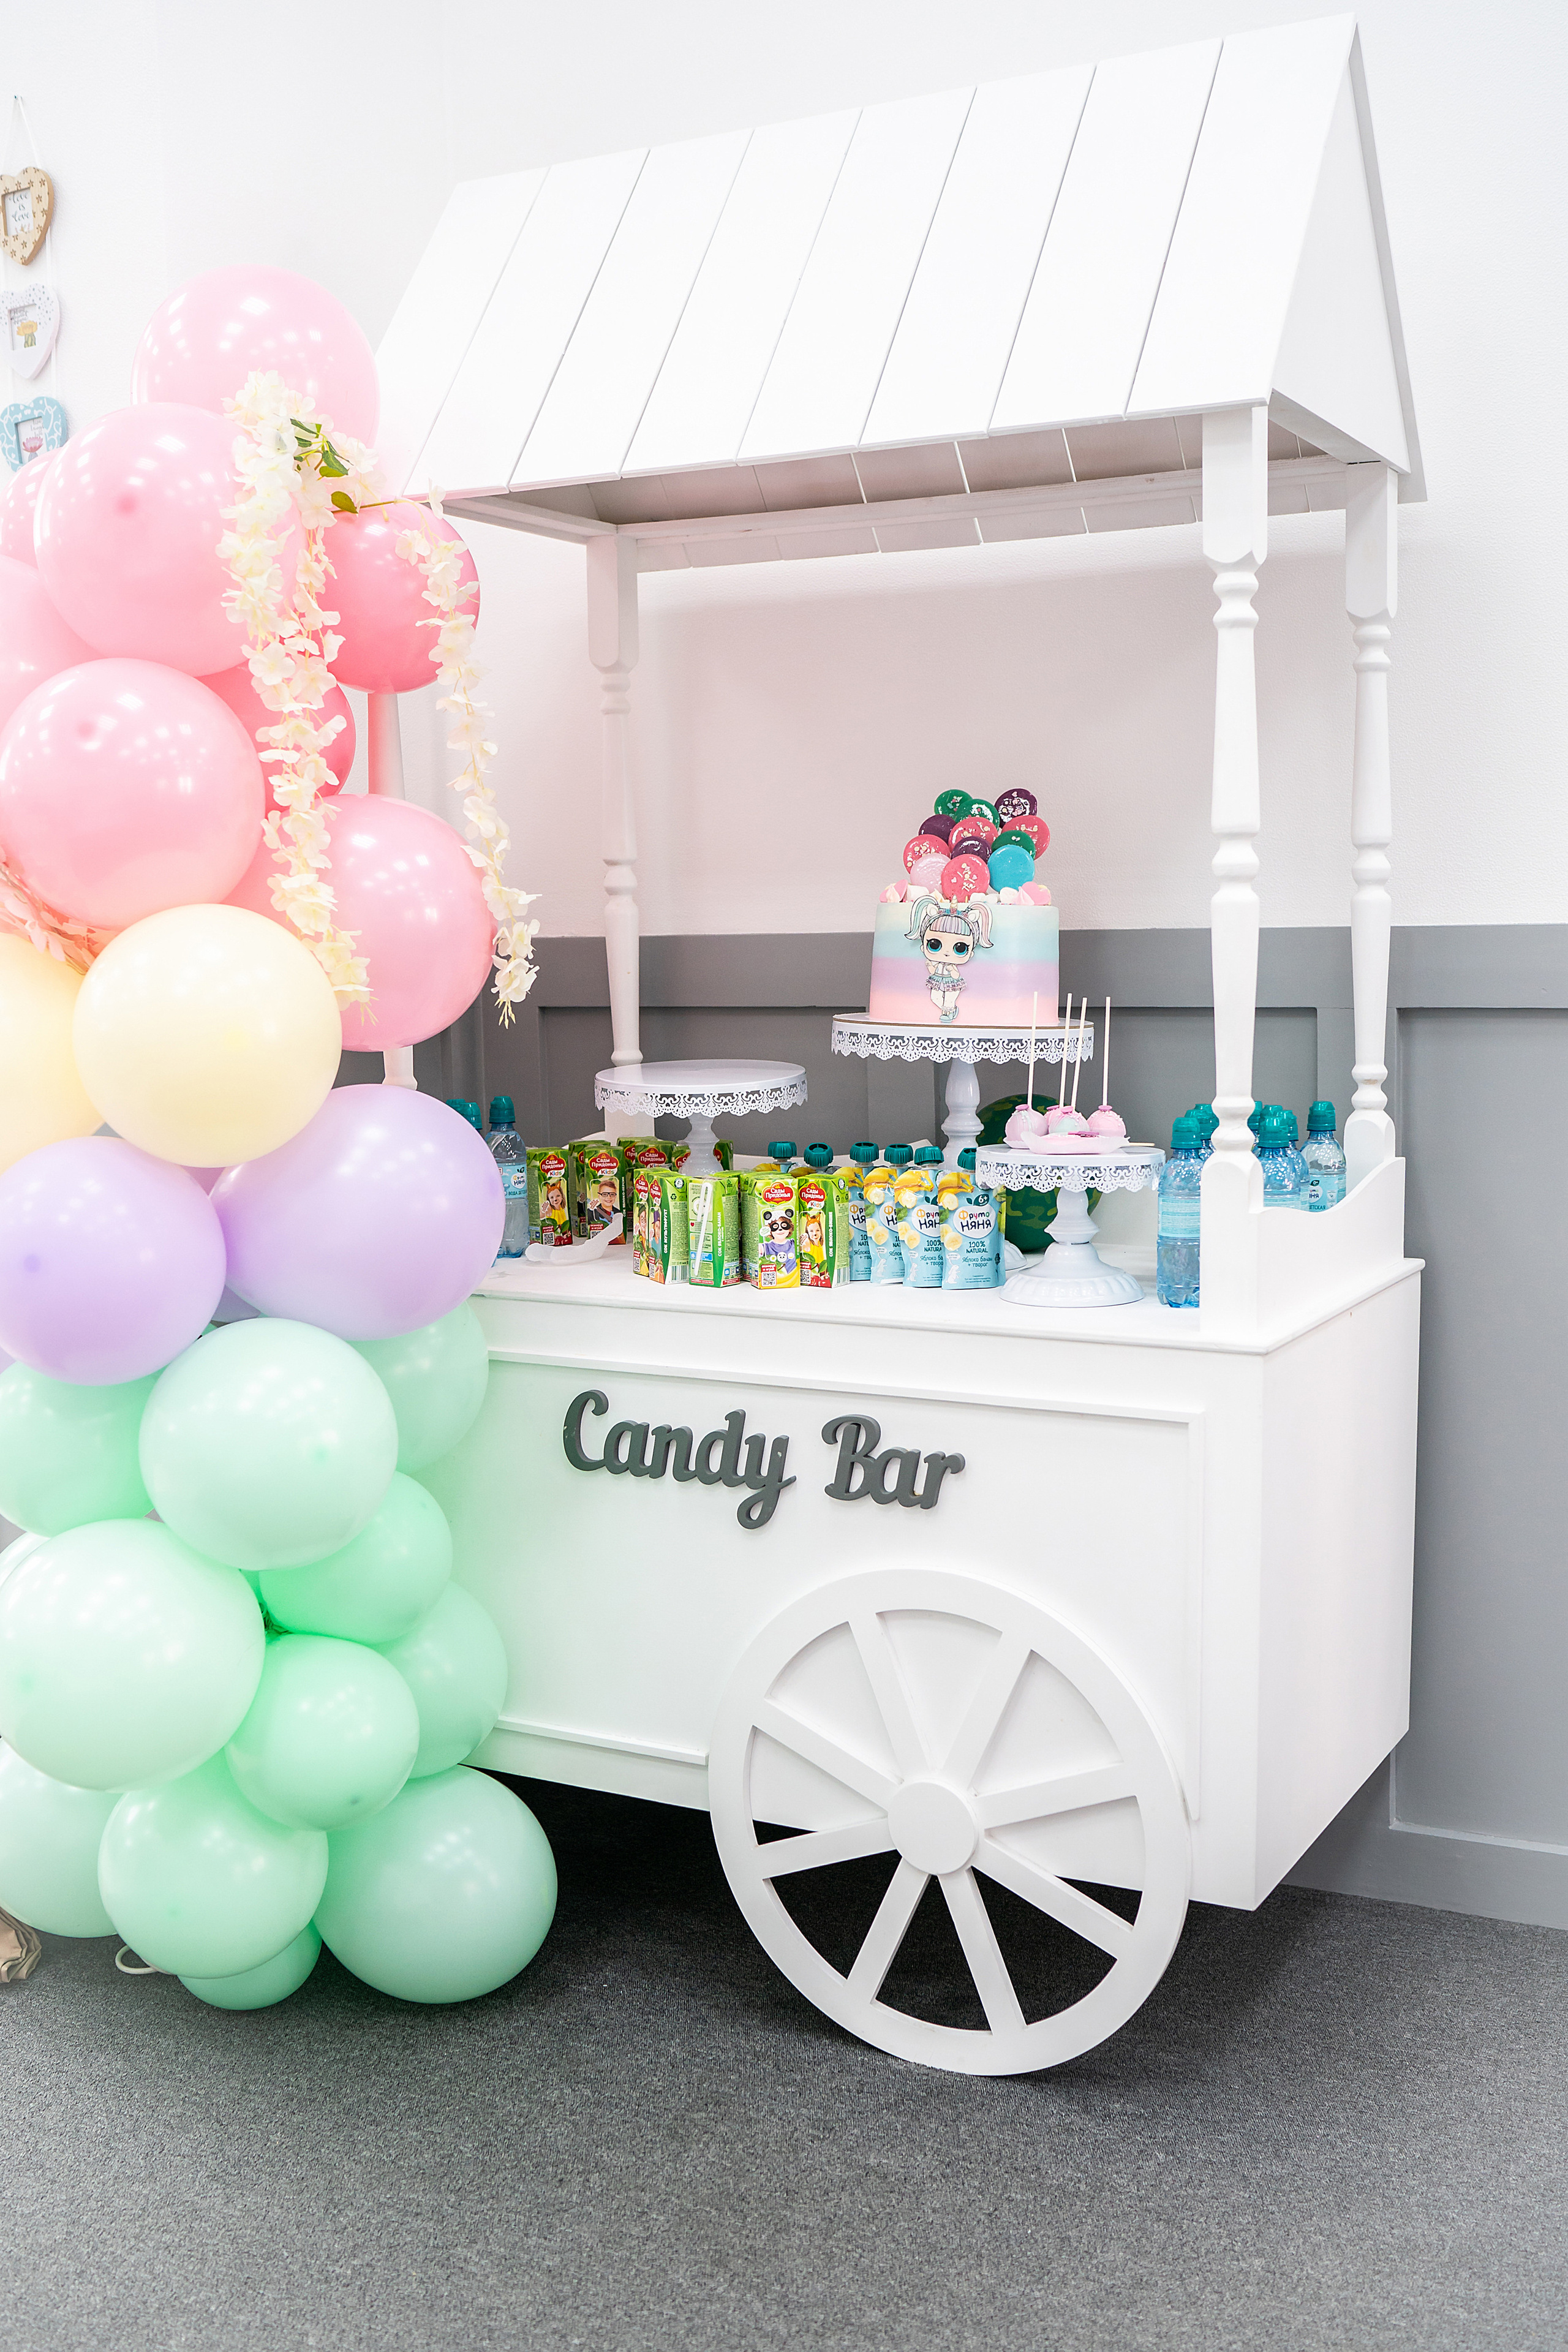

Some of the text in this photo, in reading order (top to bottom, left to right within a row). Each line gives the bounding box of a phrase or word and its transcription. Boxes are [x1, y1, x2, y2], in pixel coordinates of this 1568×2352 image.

[978, 1195, 988, 1204] 6+
[916, 1208, 940, 1219] Фрут
[959, 1210, 990, 1221] Фруто
[563, 1389, 966, 1530] Candy Bar
